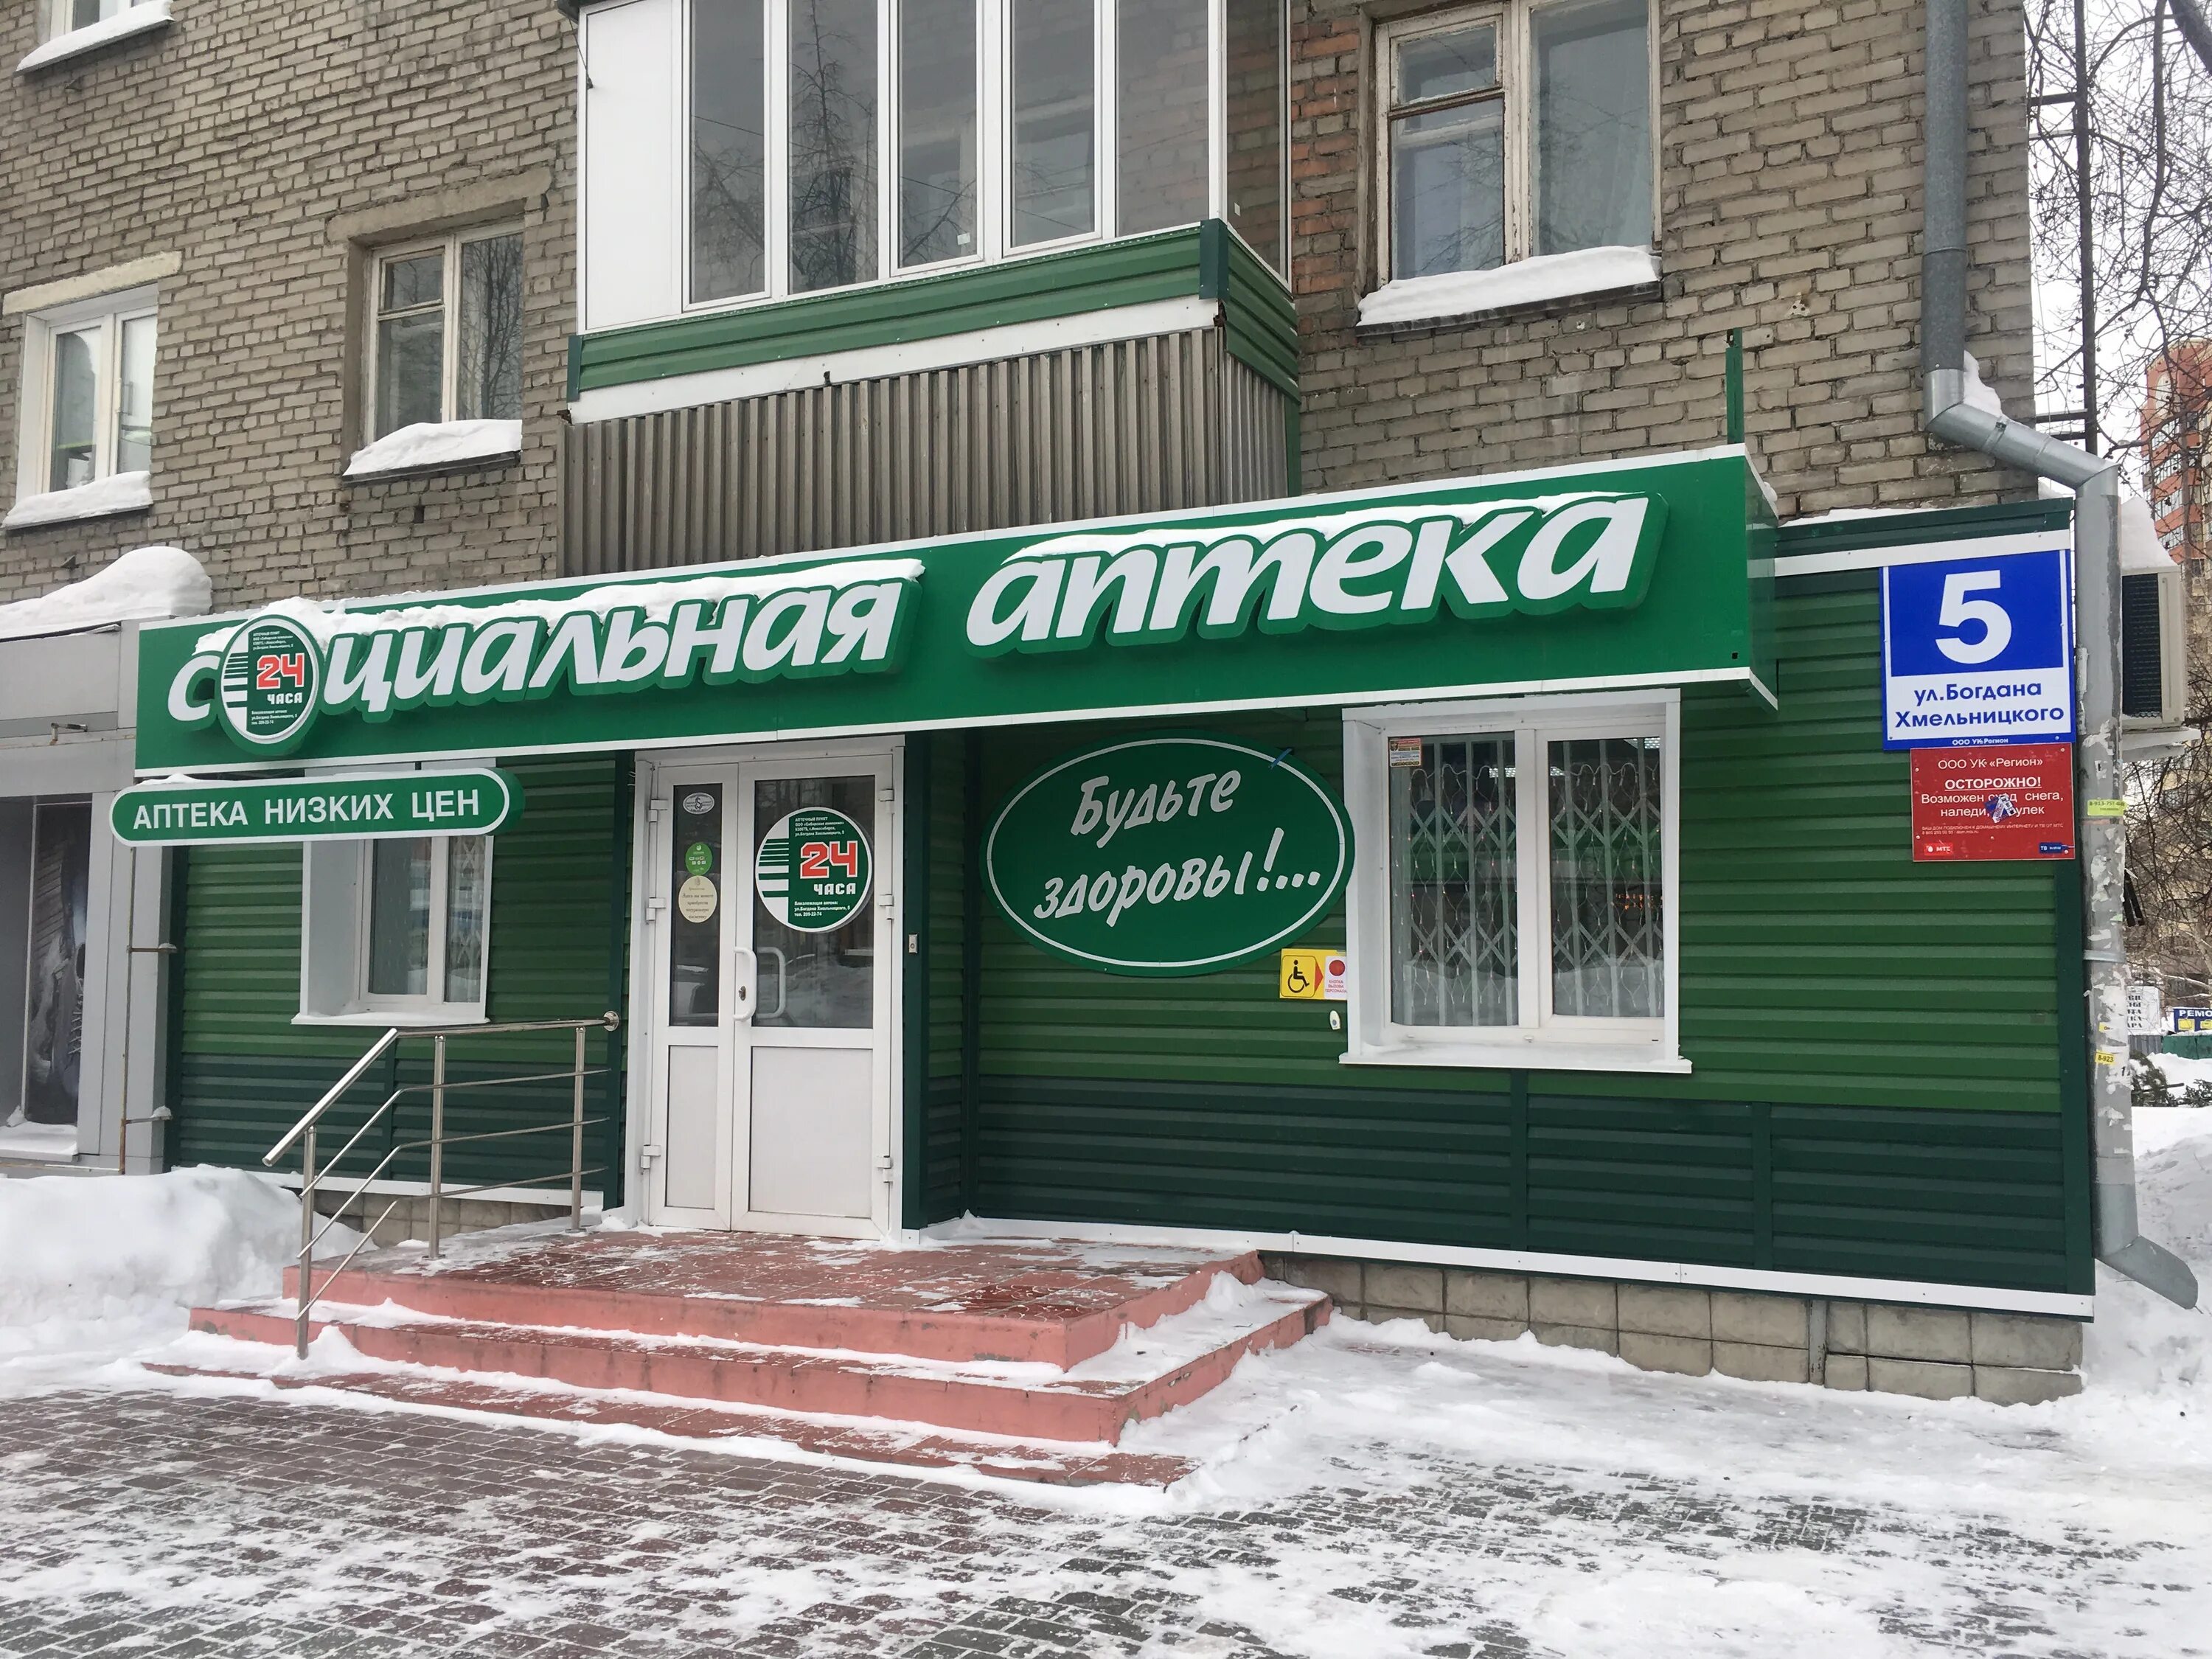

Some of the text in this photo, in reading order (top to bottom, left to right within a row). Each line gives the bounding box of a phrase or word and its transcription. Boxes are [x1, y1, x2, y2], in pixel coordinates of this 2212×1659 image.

[964, 494, 1650, 647] аптека
[1935, 569, 2012, 664] 5
[257, 653, 305, 689] 24
[267, 692, 302, 704] ЧАСА
[1913, 680, 2042, 706] ул.Богдана
[1895, 708, 2065, 728] Хмельницкого
[1938, 759, 1966, 769] ООО
[1989, 758, 2043, 768] «Регион»
[1944, 776, 2042, 790] ОСТОРОЖНО!
[133, 789, 479, 830] АПТЕКА НИЗКИХ ЦЕН
[1069, 769, 1242, 848] Будьте
[1921, 793, 1984, 804] Возможен
[2025, 792, 2064, 801] снега,
[1940, 806, 1990, 818] наледи,
[799, 840, 858, 879] 24
[813, 883, 856, 895] ЧАСА
